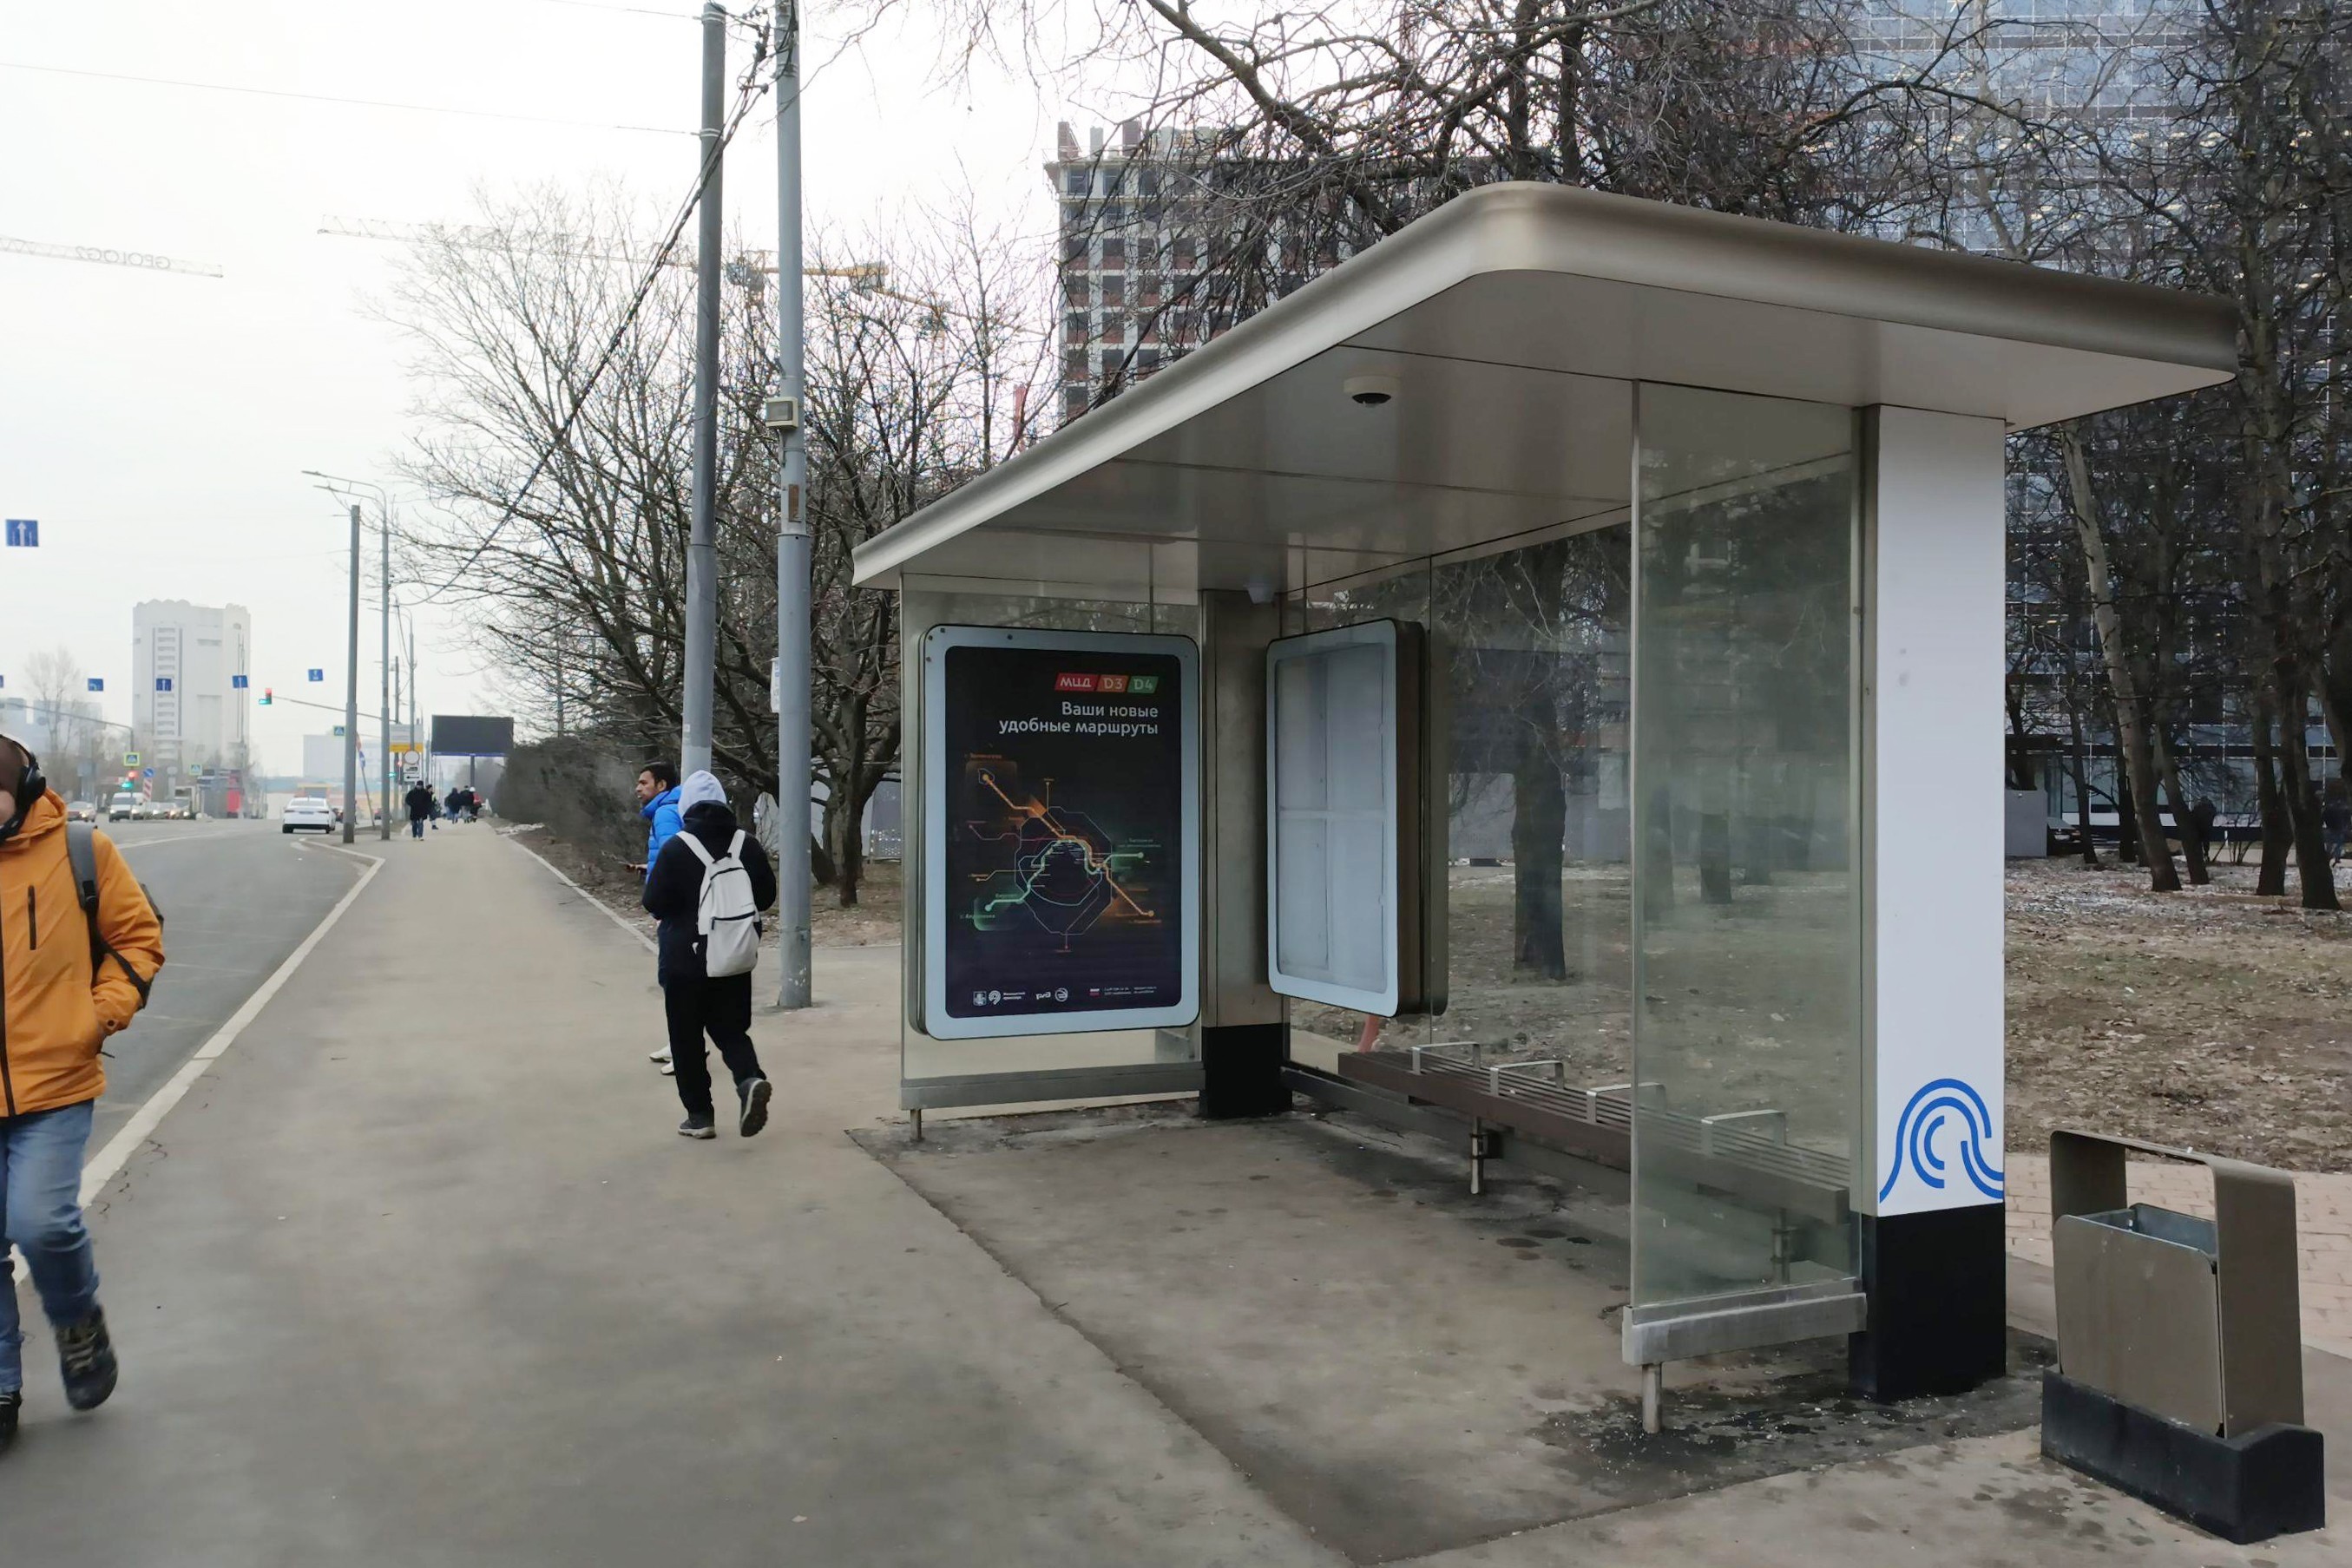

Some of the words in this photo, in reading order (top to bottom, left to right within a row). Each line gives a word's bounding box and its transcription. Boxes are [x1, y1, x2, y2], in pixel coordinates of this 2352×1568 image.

[1060, 676, 1092, 688] МЦД
[1103, 677, 1123, 690] D3
[1133, 678, 1153, 691] D4
[1061, 701, 1105, 716] Ваши
[1109, 705, 1159, 718] новые
[999, 718, 1071, 734] удобные
[1075, 722, 1159, 737] маршруты
